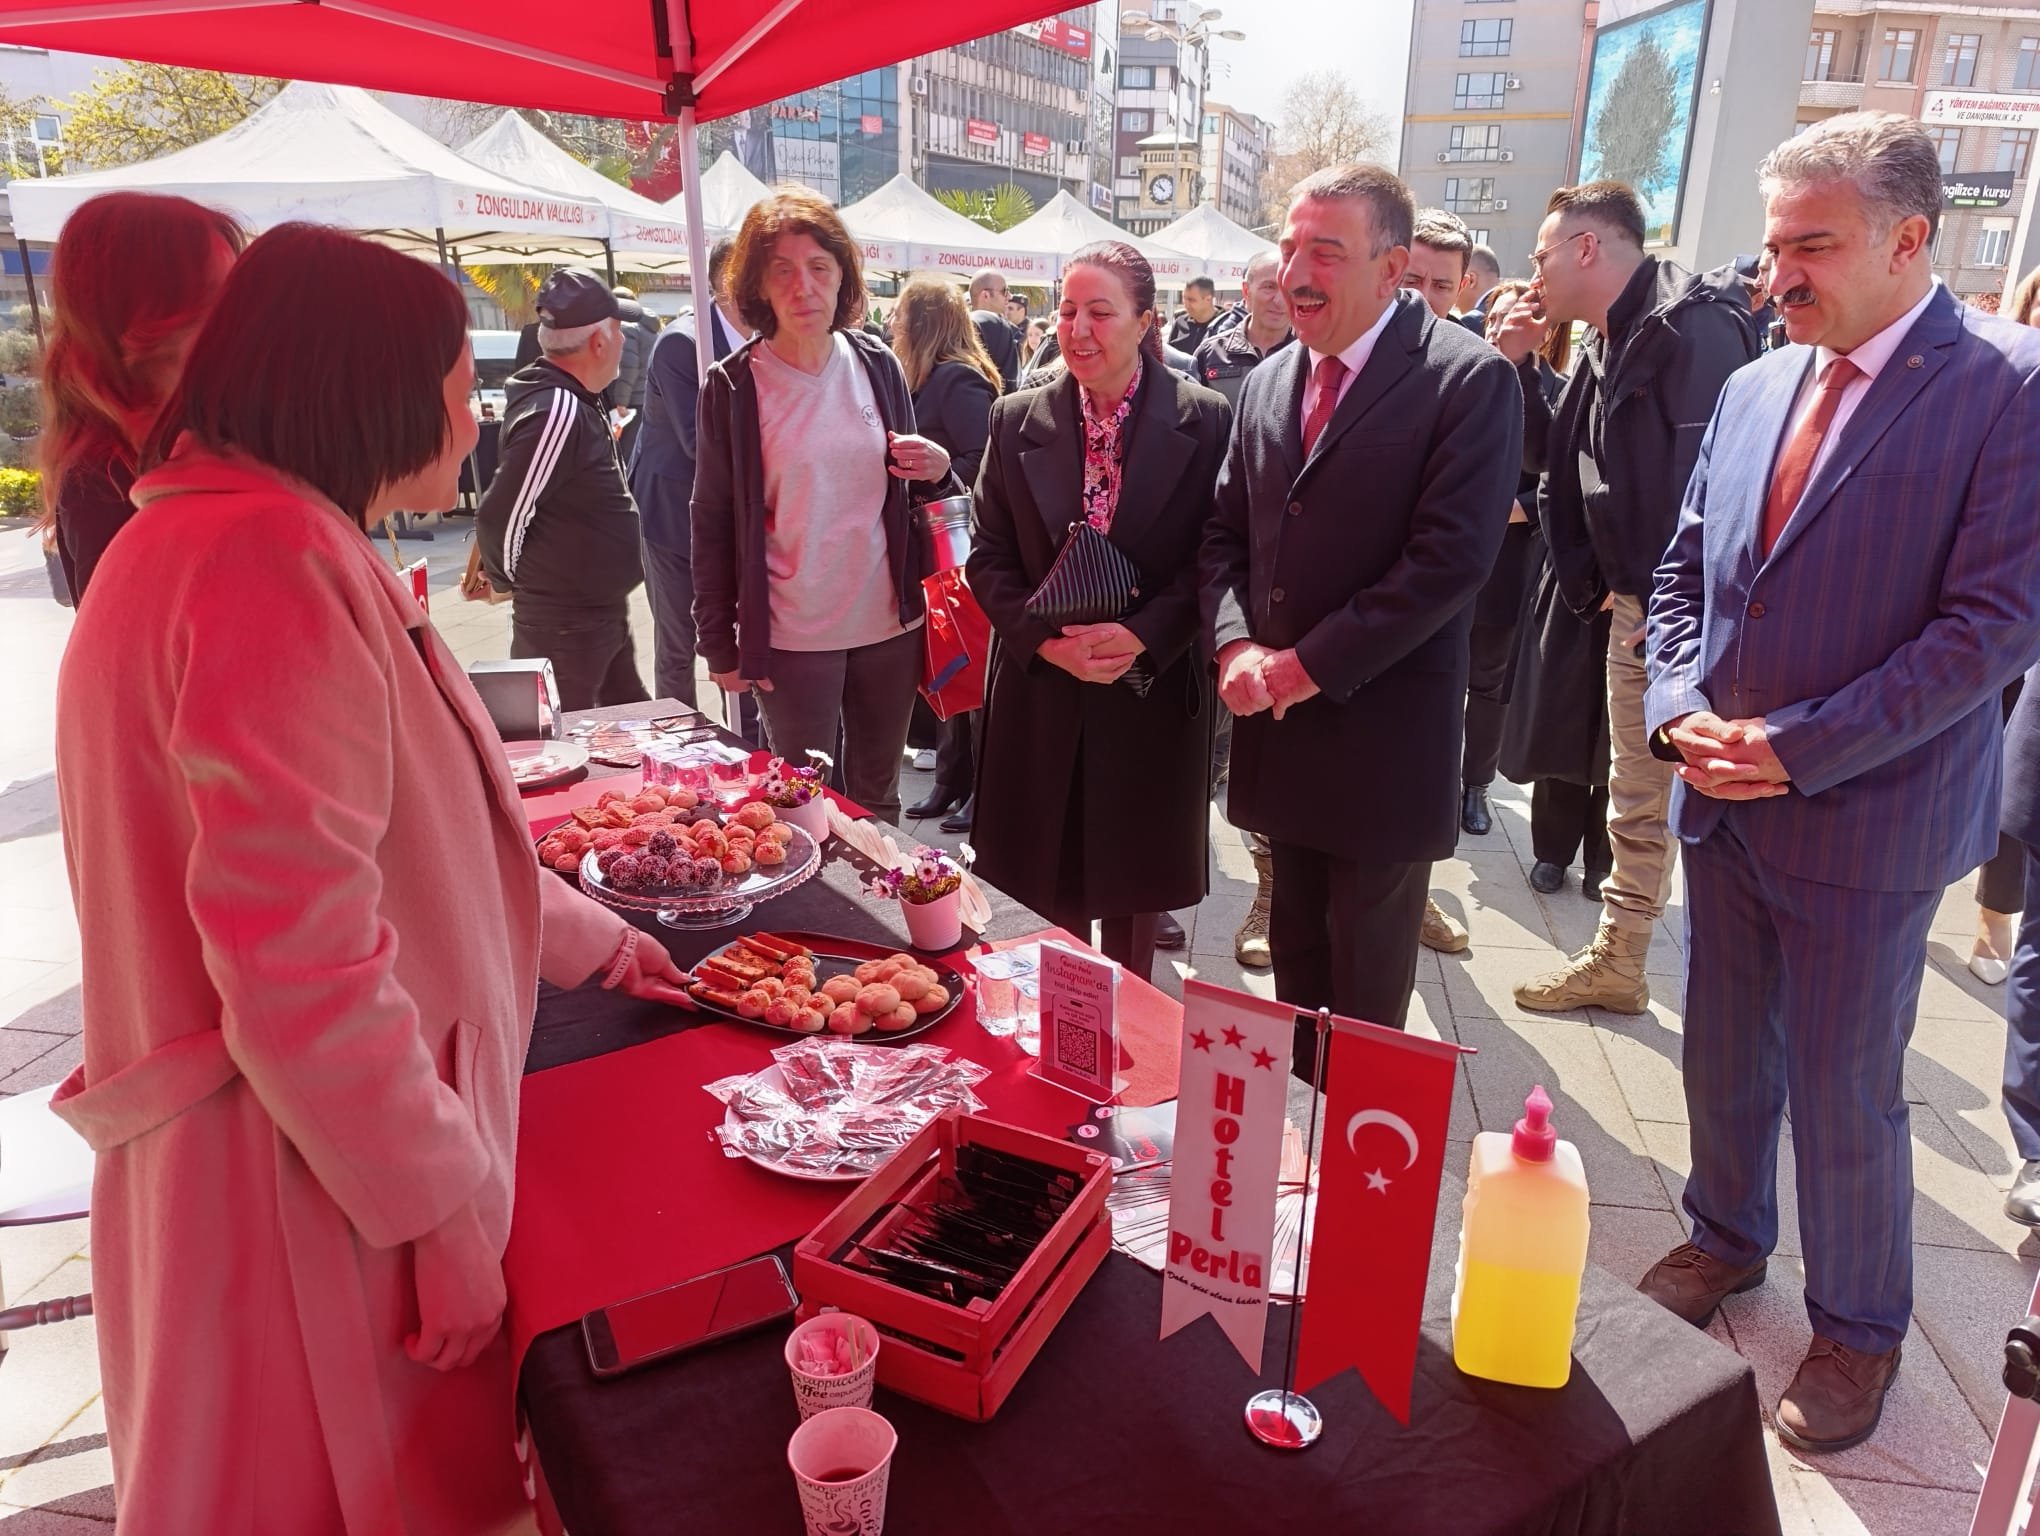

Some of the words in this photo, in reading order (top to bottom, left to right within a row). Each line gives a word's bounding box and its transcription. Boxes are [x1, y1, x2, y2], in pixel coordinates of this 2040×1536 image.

[1949, 97, 1978, 109] YÖNTEM
[1957, 111, 1964, 119] VE
[1942, 182, 1980, 199] ngilizce
[1982, 185, 2011, 198] kursu
[476, 193, 544, 220] ZONGULDAK
[938, 252, 996, 267] ZONGULDAK
[999, 256, 1033, 271] VALİLİĞİ
[1151, 261, 1179, 274] ALİLİĞİ
[1210, 1073, 1246, 1242] Hotel
[1171, 1231, 1261, 1288] Perla
